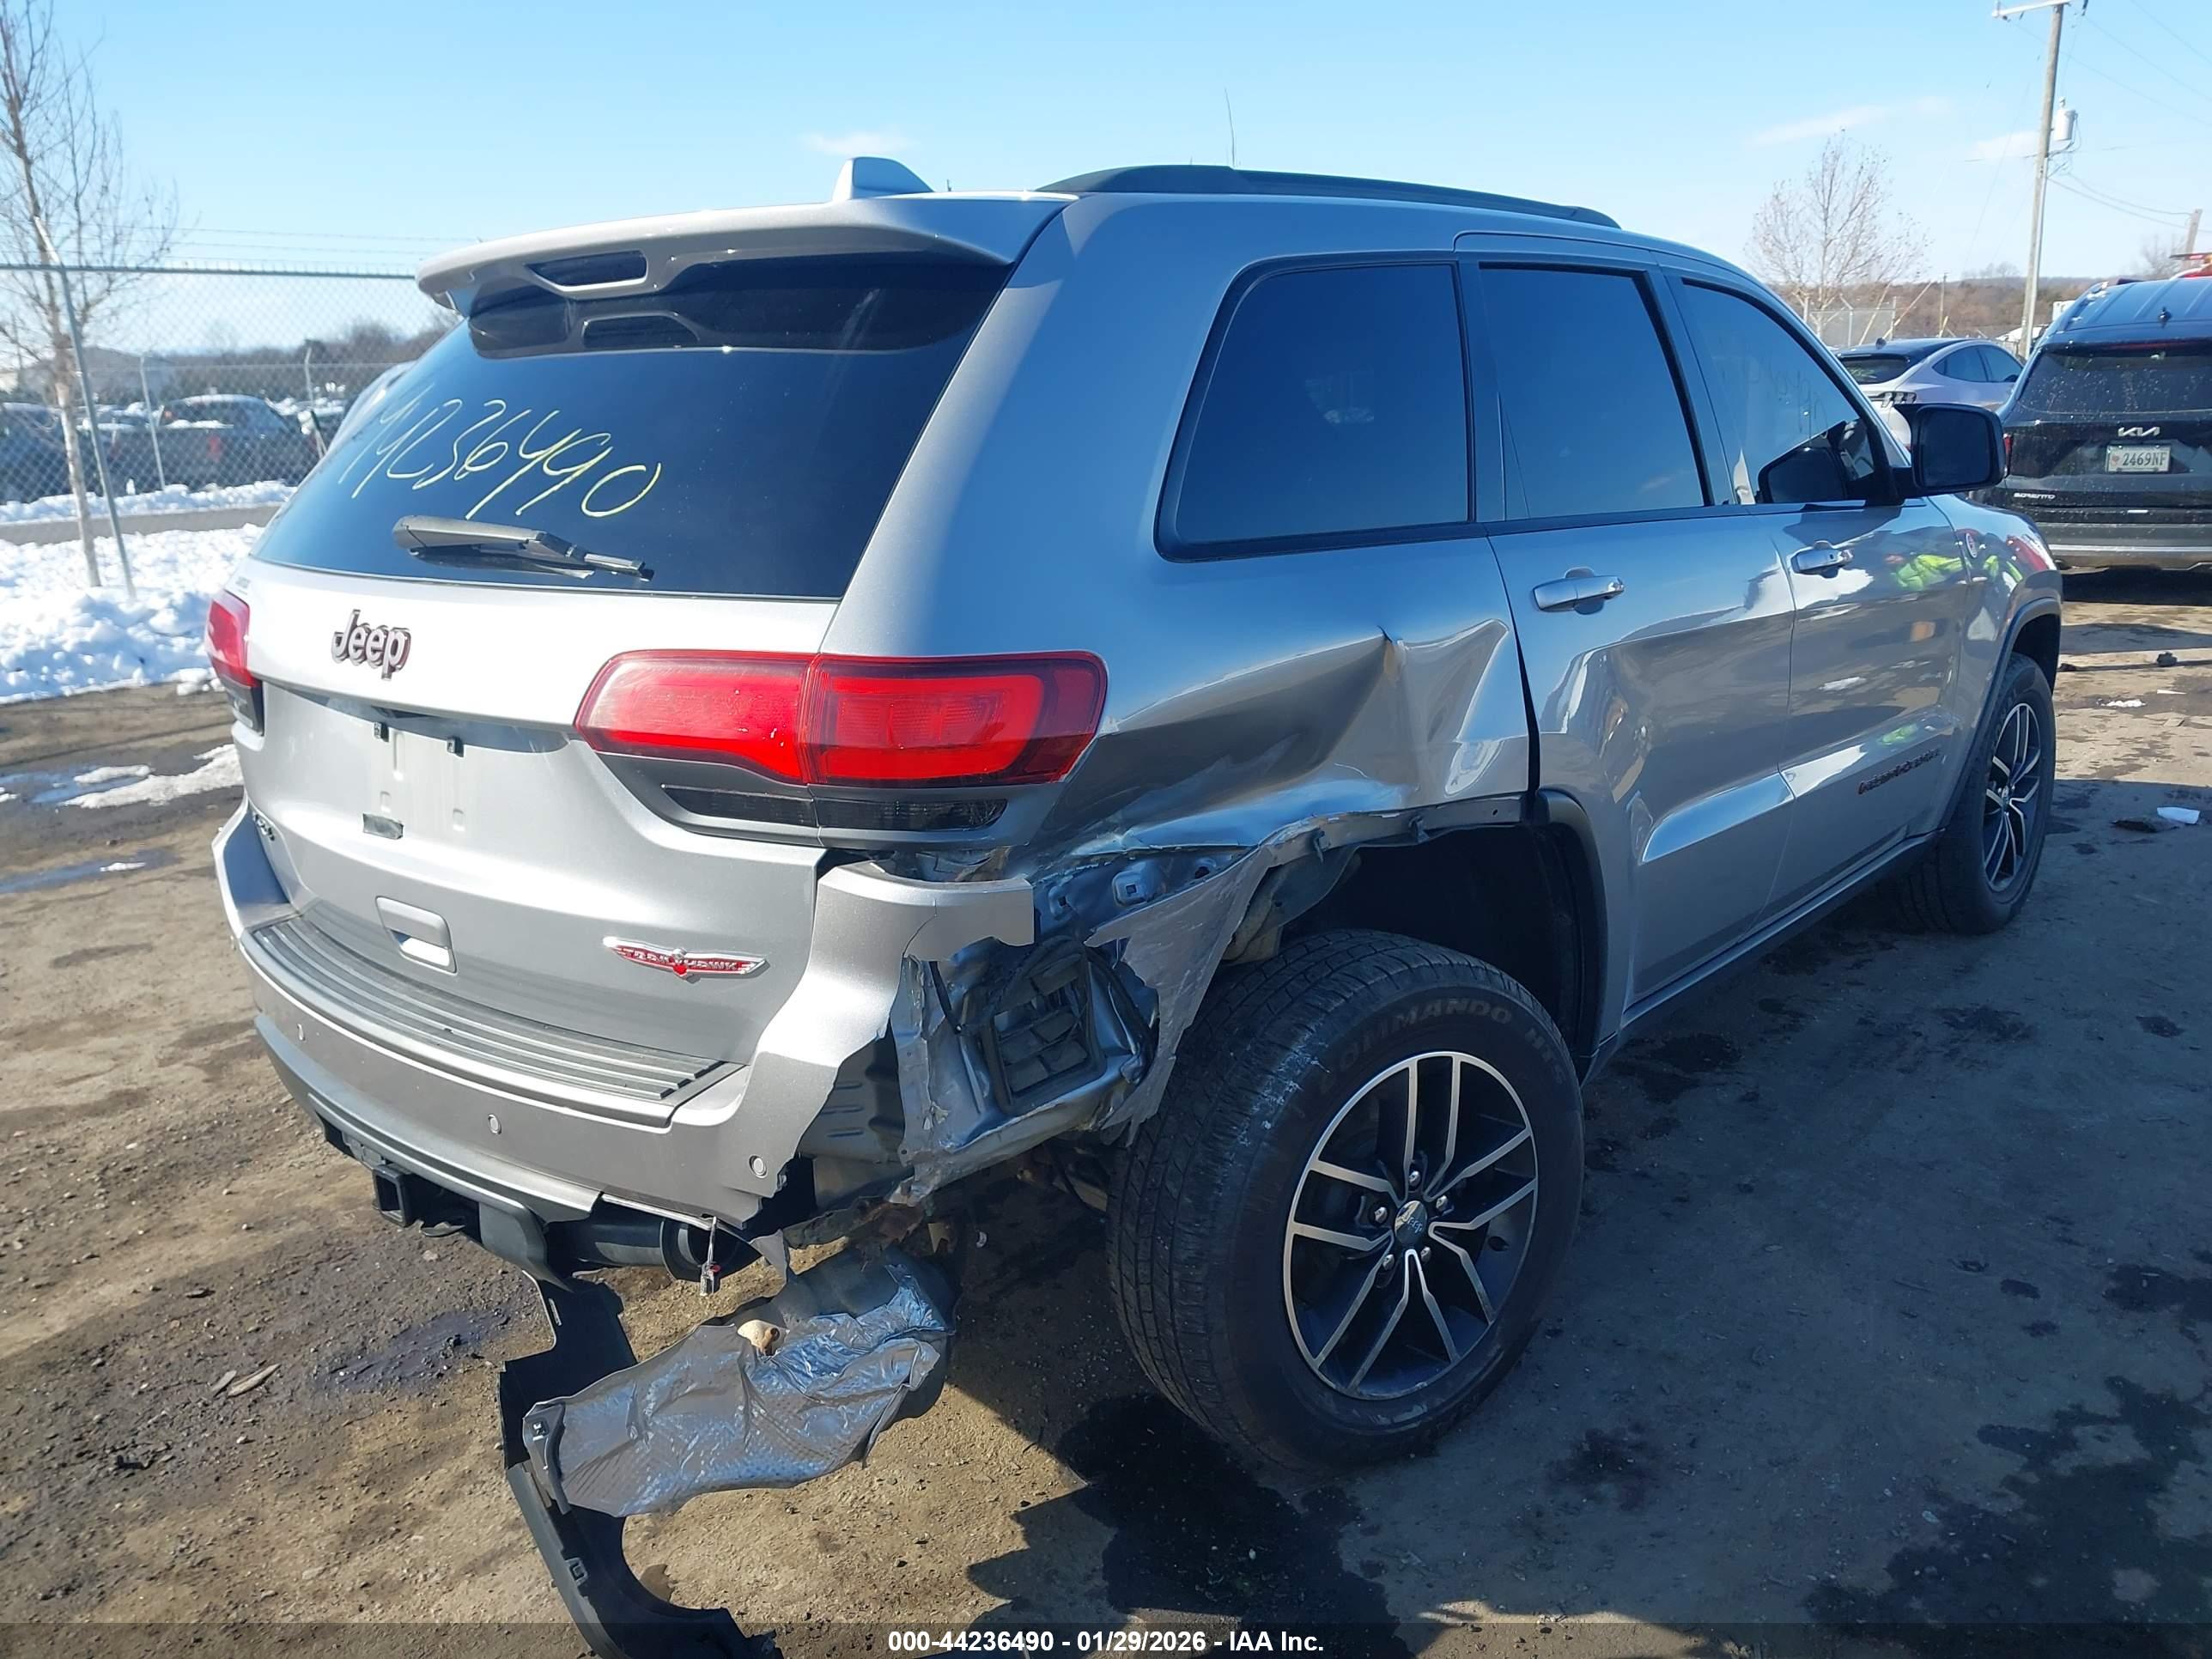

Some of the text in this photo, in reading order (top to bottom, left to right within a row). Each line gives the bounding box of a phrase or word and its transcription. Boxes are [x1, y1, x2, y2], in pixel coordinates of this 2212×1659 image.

[2118, 426, 2160, 437] KIA
[2122, 452, 2168, 466] 2469NF
[331, 609, 412, 682] Jeep
